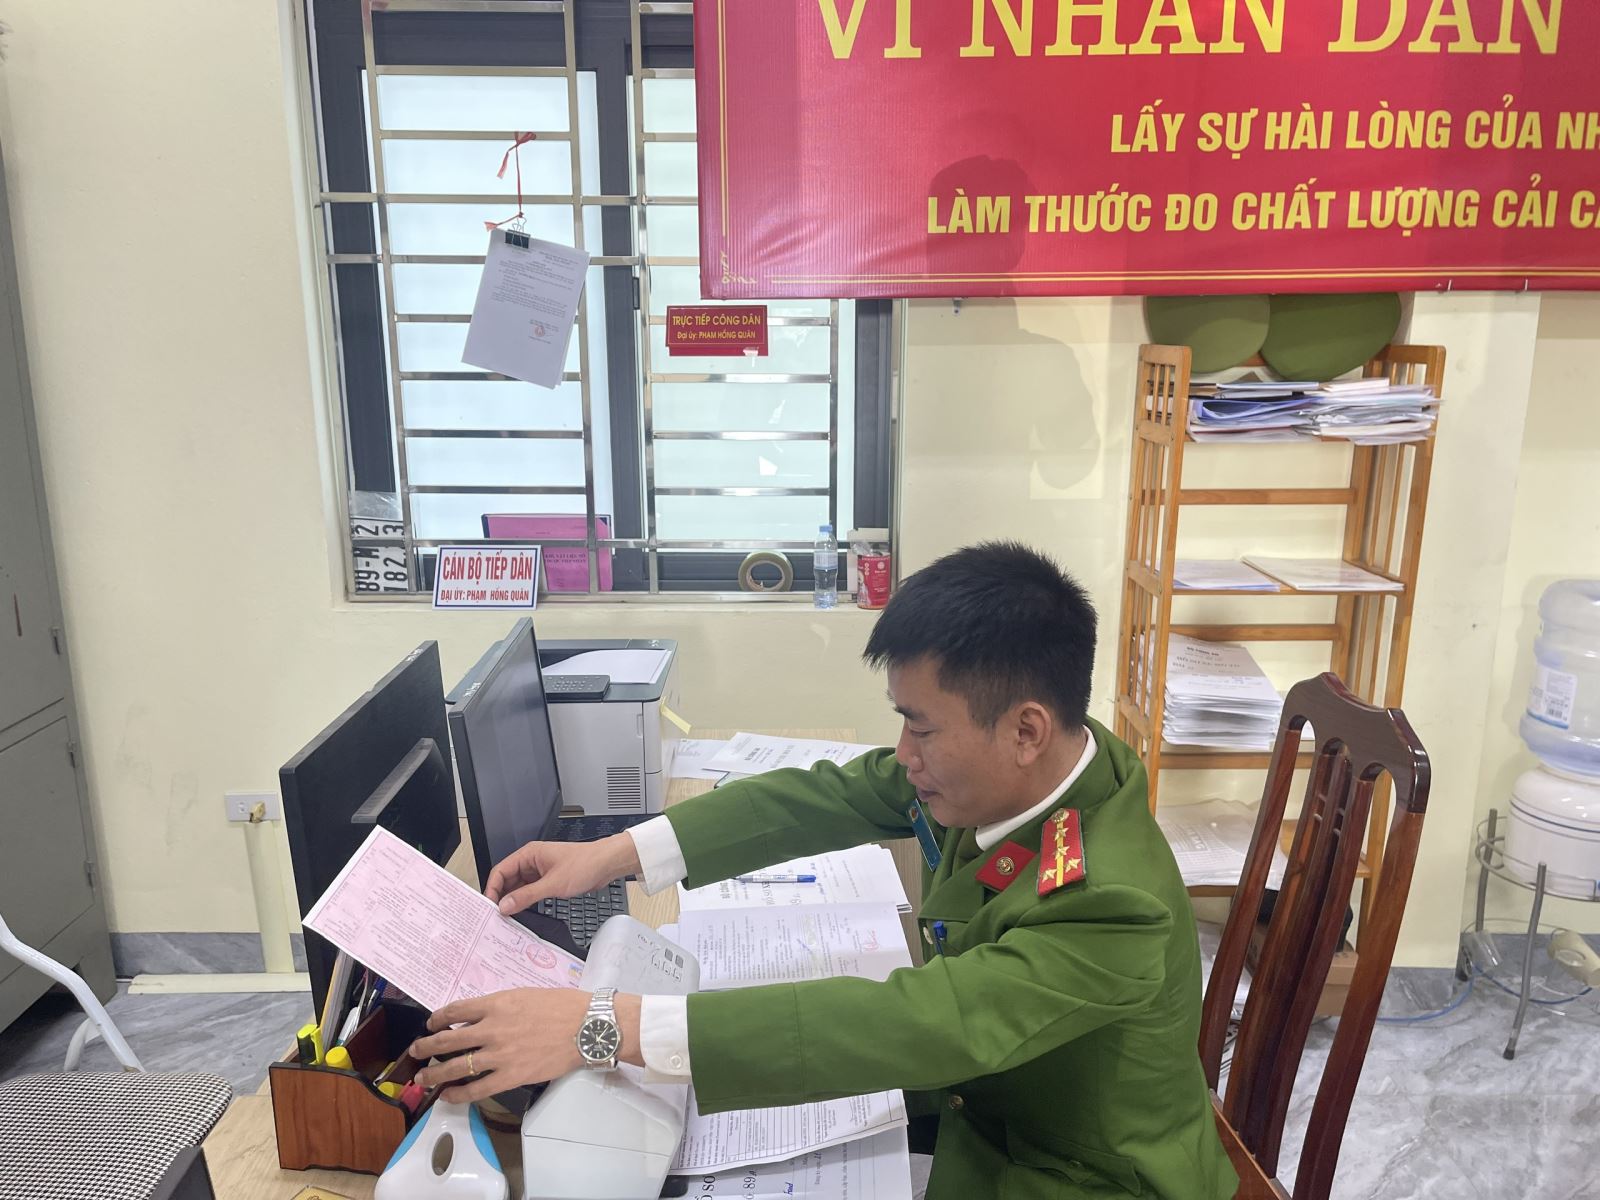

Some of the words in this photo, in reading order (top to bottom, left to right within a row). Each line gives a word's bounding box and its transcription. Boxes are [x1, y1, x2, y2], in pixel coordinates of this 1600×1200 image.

[1110, 99, 1186, 153] LẤY
[1197, 107, 1259, 160] SỰ
[1264, 102, 1334, 150] HÀI
[1345, 100, 1452, 149] LÒNG
[1464, 93, 1543, 150] CỦA
[927, 188, 1011, 234] LÀM
[1024, 183, 1152, 233] THƯỚC
[1164, 192, 1218, 232] ĐO
[1232, 177, 1337, 232] CHẤT
[1347, 186, 1481, 237] LƯỢNG
[1492, 173, 1559, 229] CẢI
[672, 315, 693, 328] TRỰC
[695, 312, 711, 326] TIẾP
[712, 313, 740, 326] CÔNG
[742, 313, 761, 325] DÂN
[382, 524, 408, 592] 182.3
[442, 551, 466, 581] CÁN
[467, 551, 483, 586] BỘ
[485, 549, 508, 581] TIẾP
[510, 551, 533, 581] DÂN
[440, 589, 453, 603] ĐẠI
[466, 589, 487, 603] PHẠM
